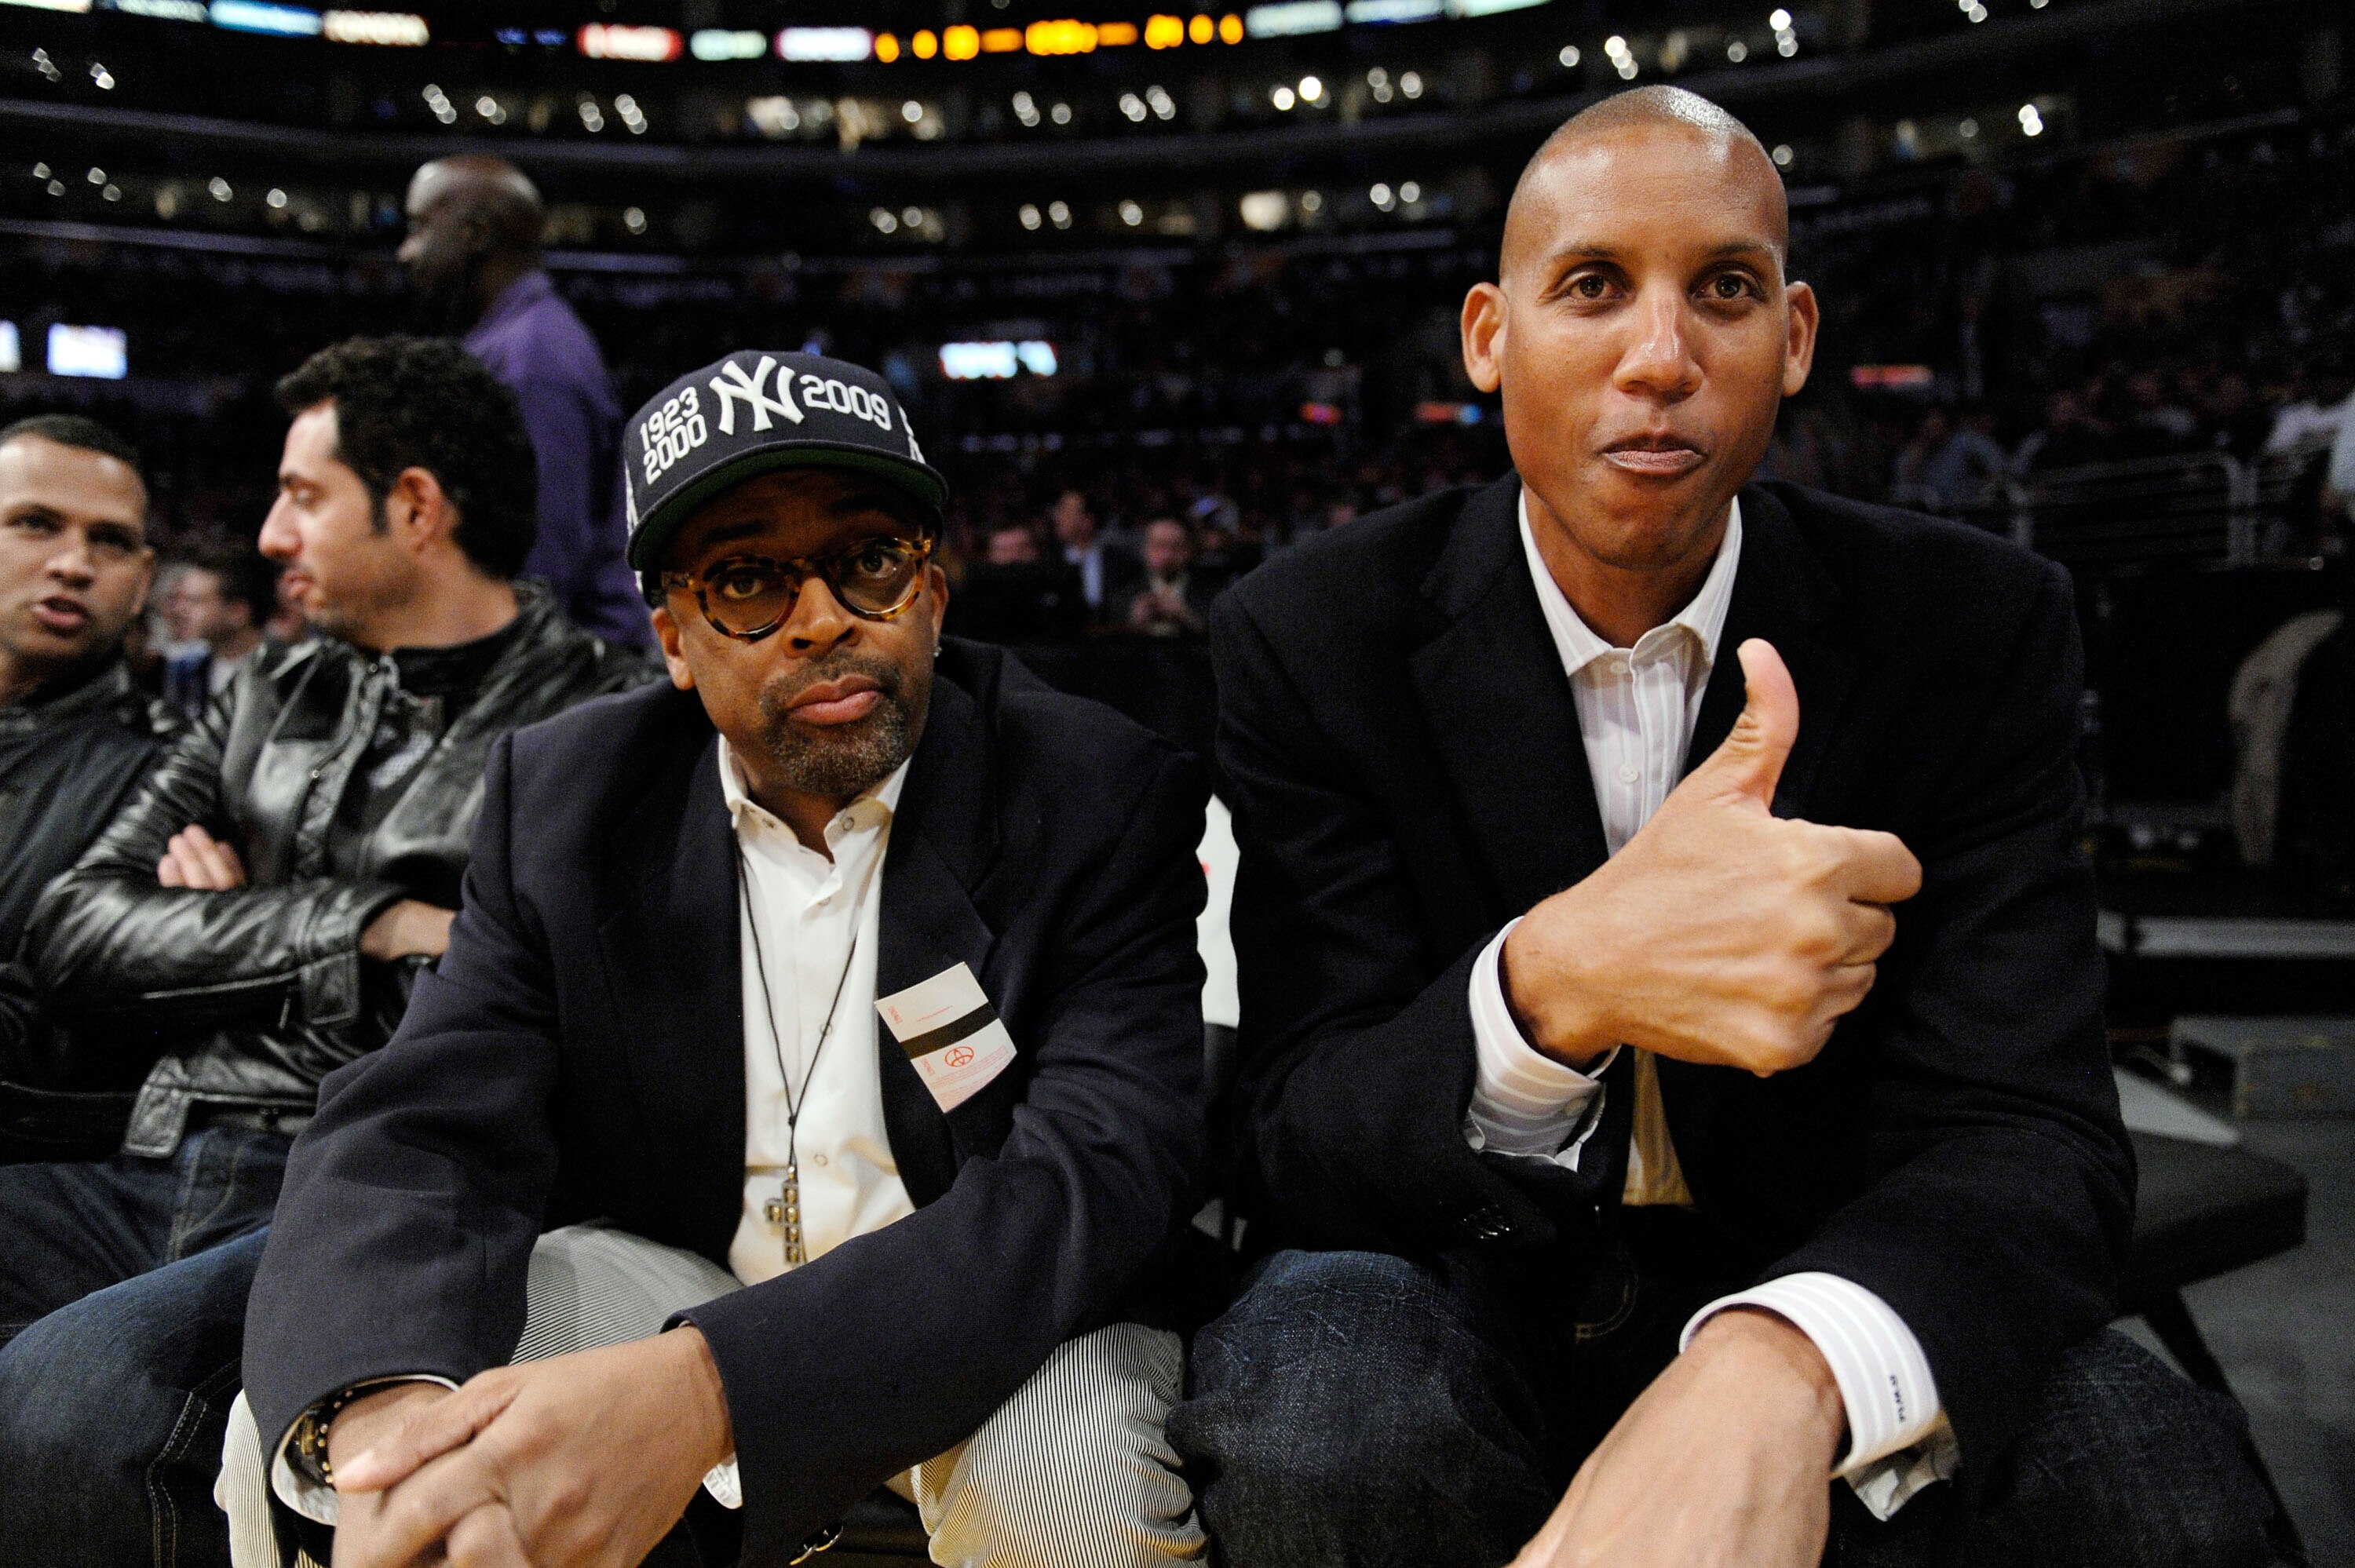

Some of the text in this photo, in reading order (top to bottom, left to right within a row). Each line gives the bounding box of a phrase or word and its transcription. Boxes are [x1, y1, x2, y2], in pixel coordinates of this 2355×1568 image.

[640, 387, 699, 450] 1923
[710, 356, 805, 435] NY
[799, 374, 892, 431] 2009
[644, 414, 707, 484] 2000
